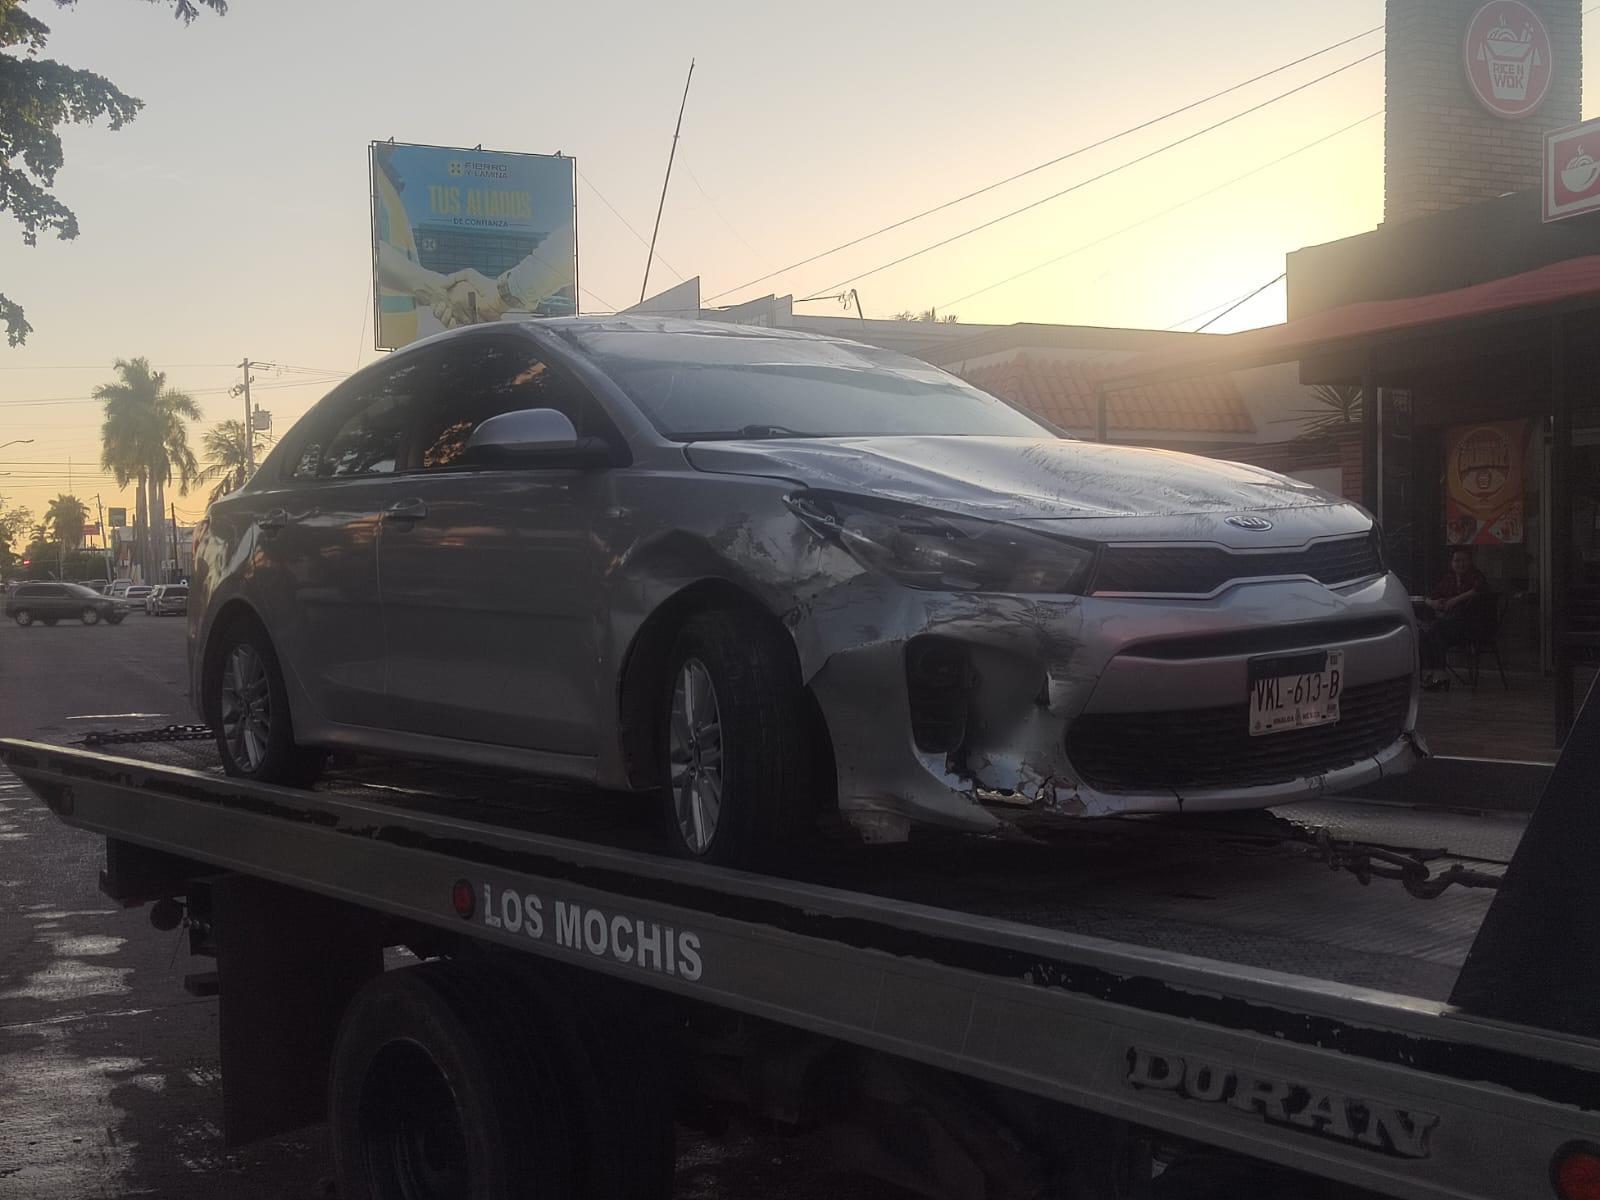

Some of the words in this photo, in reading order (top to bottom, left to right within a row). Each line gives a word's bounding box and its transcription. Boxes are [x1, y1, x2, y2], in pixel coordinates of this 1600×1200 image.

[1493, 64, 1515, 74] RICE
[1494, 73, 1524, 89] WOK
[429, 185, 460, 214] TUS
[484, 883, 544, 939] LOS
[555, 901, 703, 981] MOCHIS
[1126, 1045, 1439, 1159] DURAN
